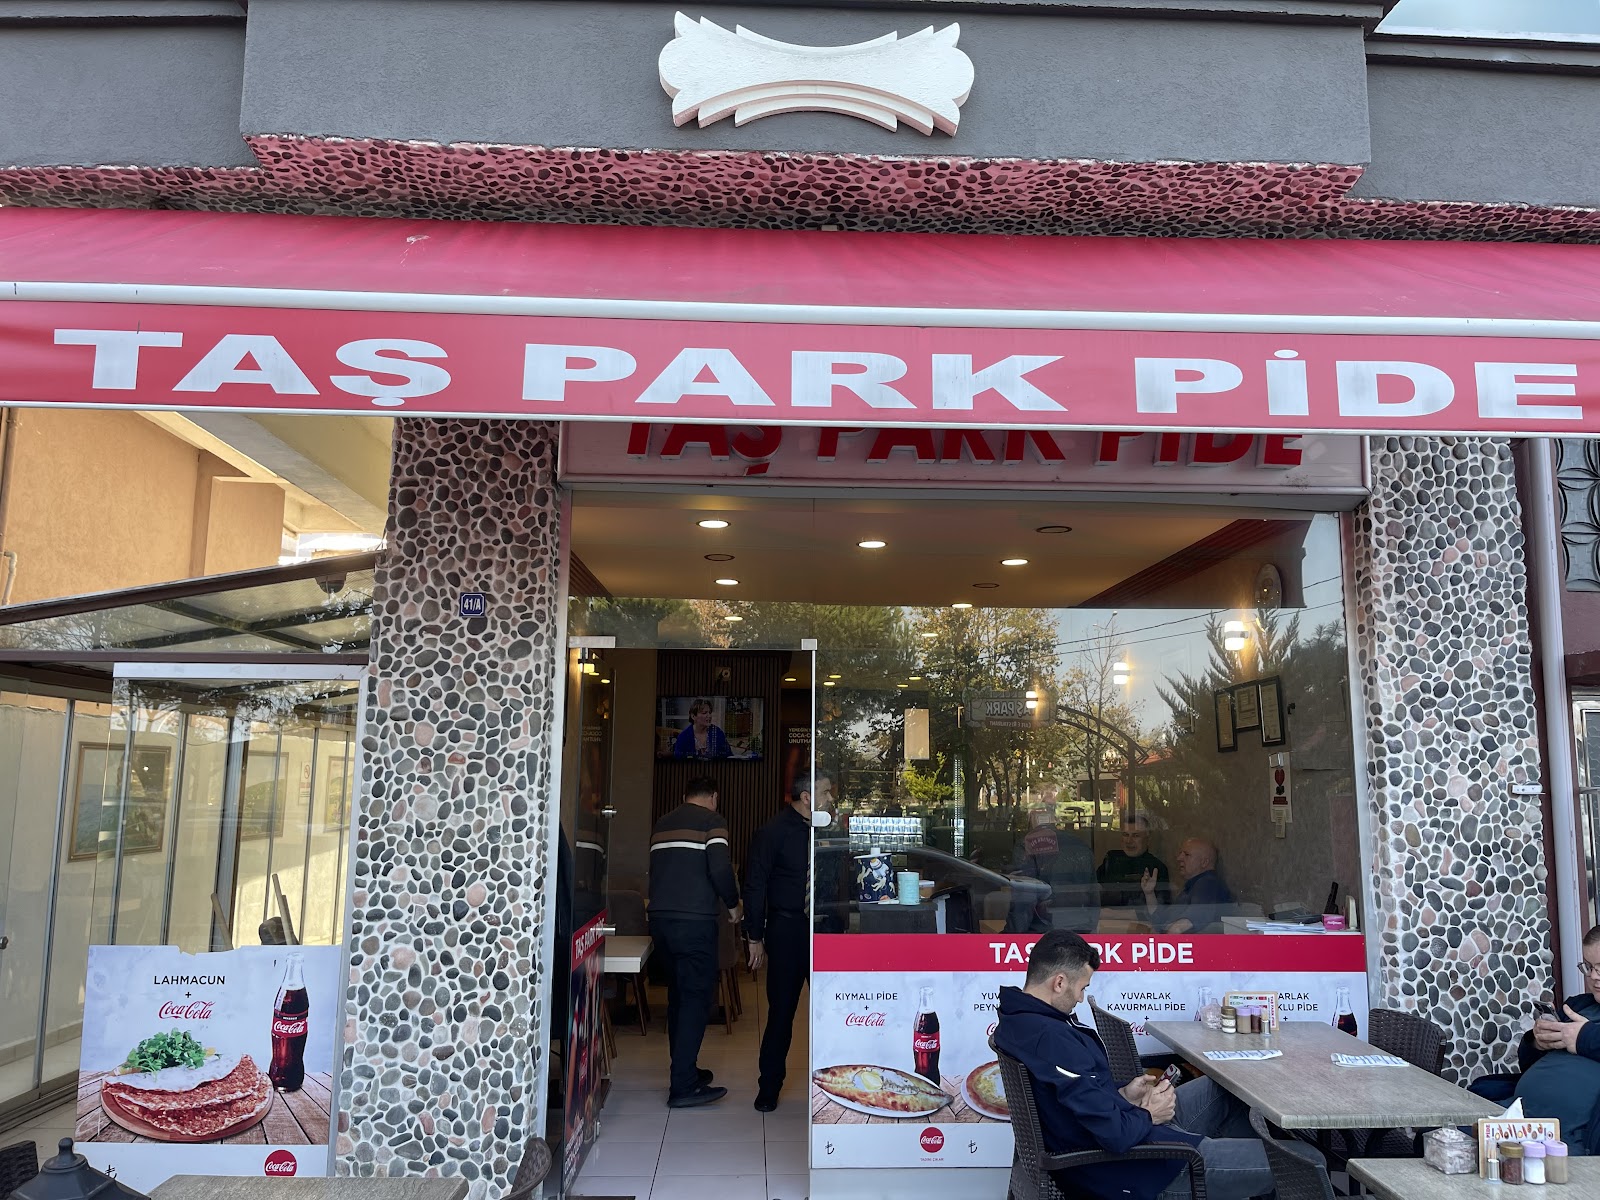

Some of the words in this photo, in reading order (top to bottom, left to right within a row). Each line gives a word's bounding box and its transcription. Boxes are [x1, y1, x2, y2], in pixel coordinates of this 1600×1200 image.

[54, 328, 452, 406] TAŞ
[522, 343, 1068, 412] PARK
[1135, 349, 1583, 420] PİDE
[463, 598, 481, 611] 41/A
[1131, 937, 1194, 964] PİDE
[154, 975, 226, 985] LAHMACUN
[835, 992, 874, 1001] KIYMALI
[876, 990, 898, 1001] PİDE
[1121, 992, 1171, 1000] YUVARLAK
[1278, 992, 1310, 1000] ARLAK
[158, 1000, 216, 1020] Coca-Cola
[1107, 1003, 1162, 1011] KAVURMALI
[1164, 1001, 1186, 1011] PİDE
[1297, 1001, 1319, 1011] PİDE
[845, 1012, 888, 1027] Coca-Cola
[273, 1020, 305, 1034] Coca-Cola
[914, 1038, 938, 1050] Coca-Cola
[920, 1135, 944, 1145] Coca-Cola
[265, 1160, 296, 1172] Coca-Cola
